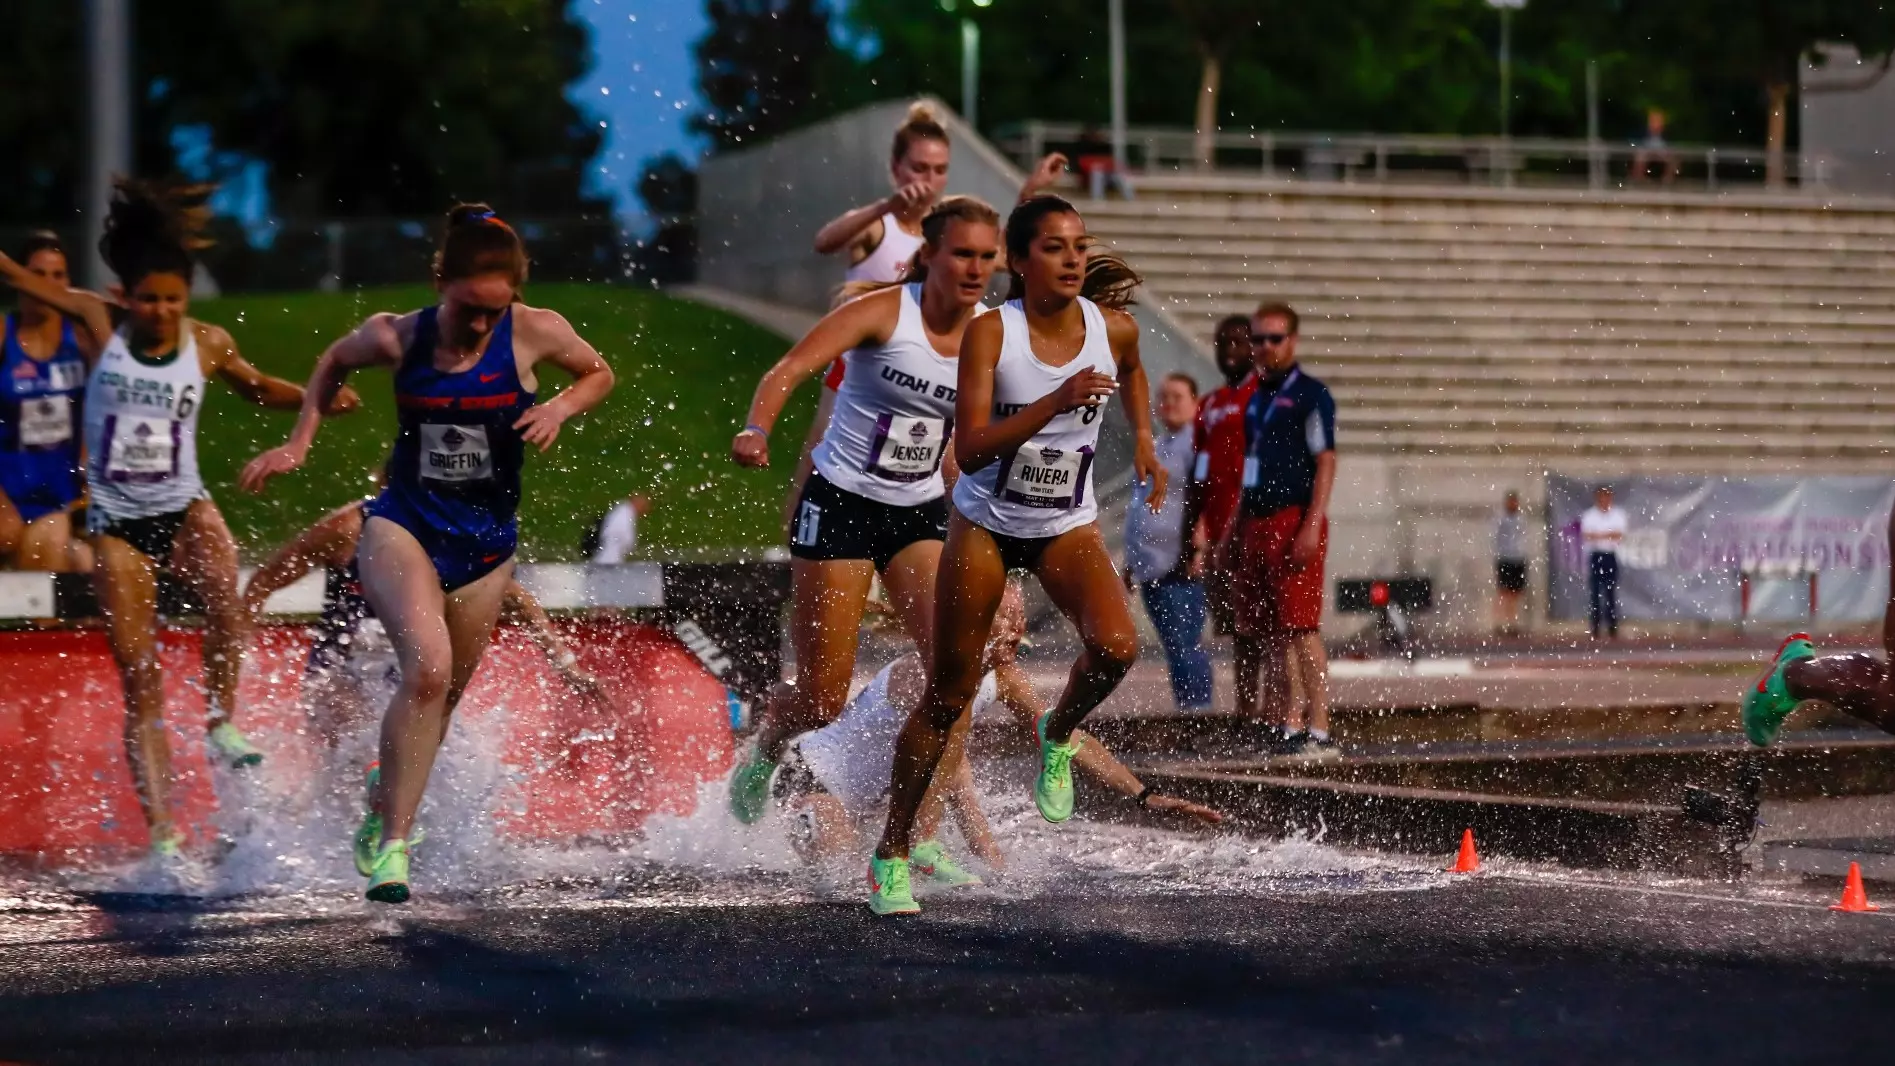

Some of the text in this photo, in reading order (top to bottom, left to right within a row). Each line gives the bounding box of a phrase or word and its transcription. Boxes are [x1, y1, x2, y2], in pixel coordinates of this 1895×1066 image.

[99, 371, 174, 394] COLORA
[881, 365, 930, 394] UTAH
[177, 385, 196, 419] 6
[429, 451, 482, 470] GRIFFIN
[891, 444, 934, 462] JENSEN
[1020, 465, 1070, 485] RIVERA
